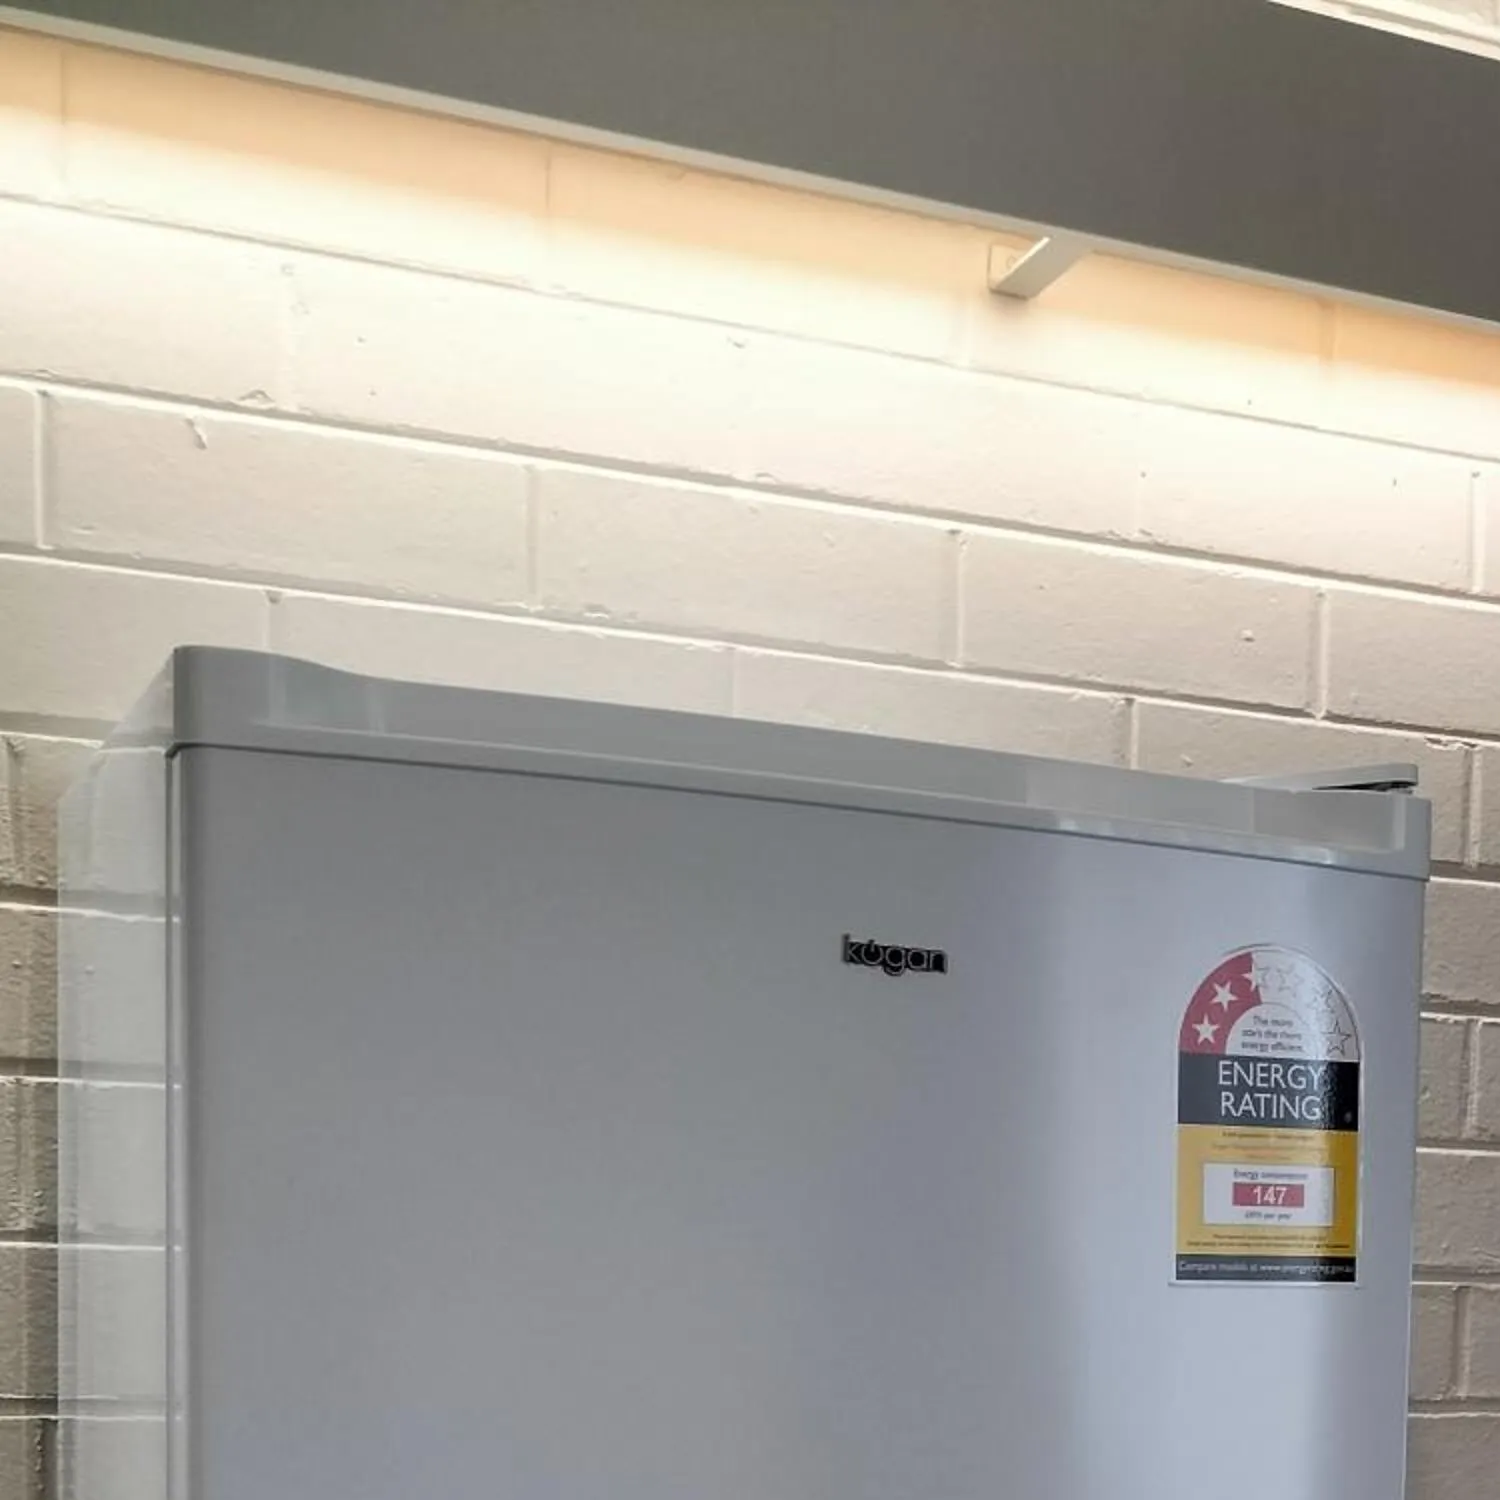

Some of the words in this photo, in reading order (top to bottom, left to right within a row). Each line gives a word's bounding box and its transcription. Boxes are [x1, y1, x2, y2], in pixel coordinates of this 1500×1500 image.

[841, 933, 949, 977] kogan
[1218, 1060, 1325, 1091] ENERGY
[1220, 1091, 1323, 1121] RATING
[1253, 1185, 1288, 1206] 147
